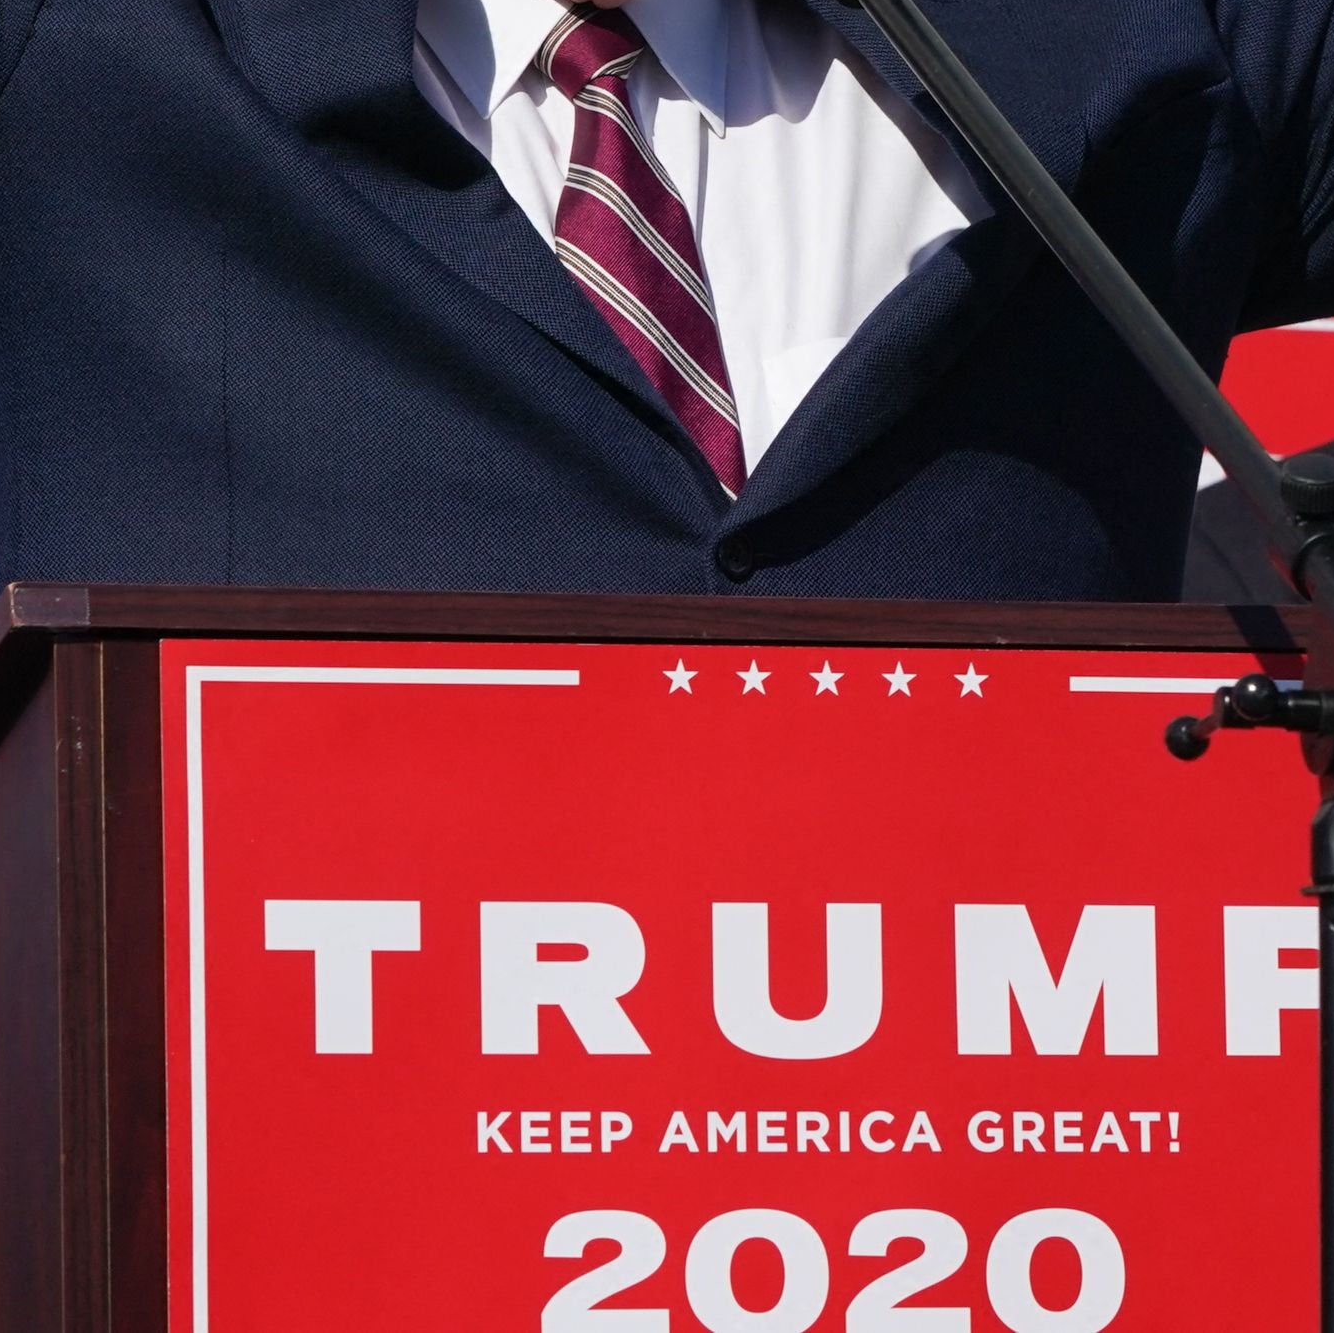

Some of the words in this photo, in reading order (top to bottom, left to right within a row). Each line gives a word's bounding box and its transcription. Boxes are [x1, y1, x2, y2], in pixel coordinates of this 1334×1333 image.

[477, 1111, 633, 1153] KEEP
[658, 1110, 942, 1153] AMERICA
[967, 1110, 1180, 1153] GREAT!
[540, 1207, 1126, 1333] 2020
